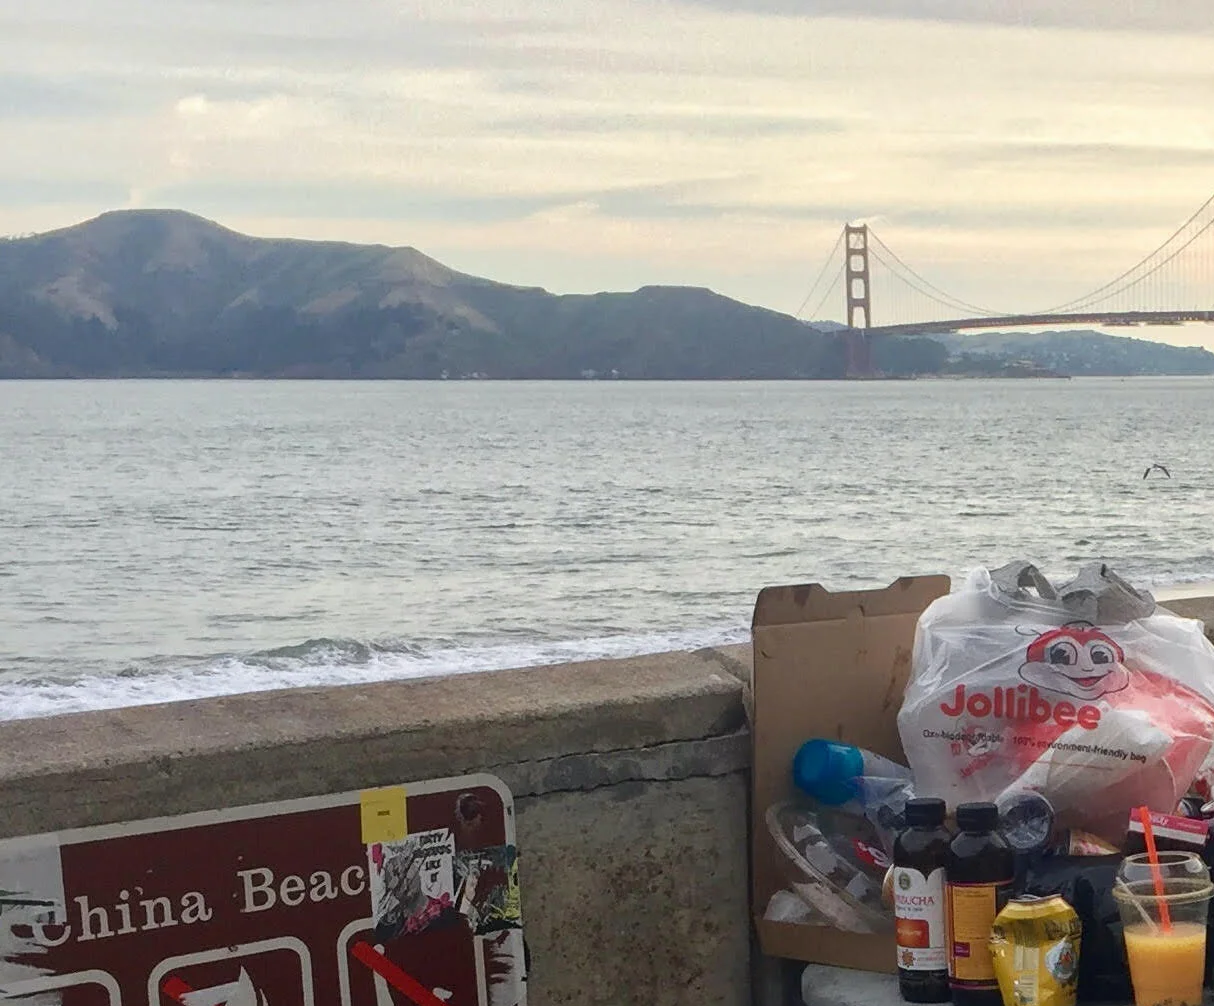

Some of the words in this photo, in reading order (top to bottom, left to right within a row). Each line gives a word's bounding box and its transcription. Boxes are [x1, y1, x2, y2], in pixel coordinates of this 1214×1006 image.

[940, 683, 1102, 731] Jollibee
[1130, 751, 1148, 764] bag
[236, 864, 372, 913] Beac
